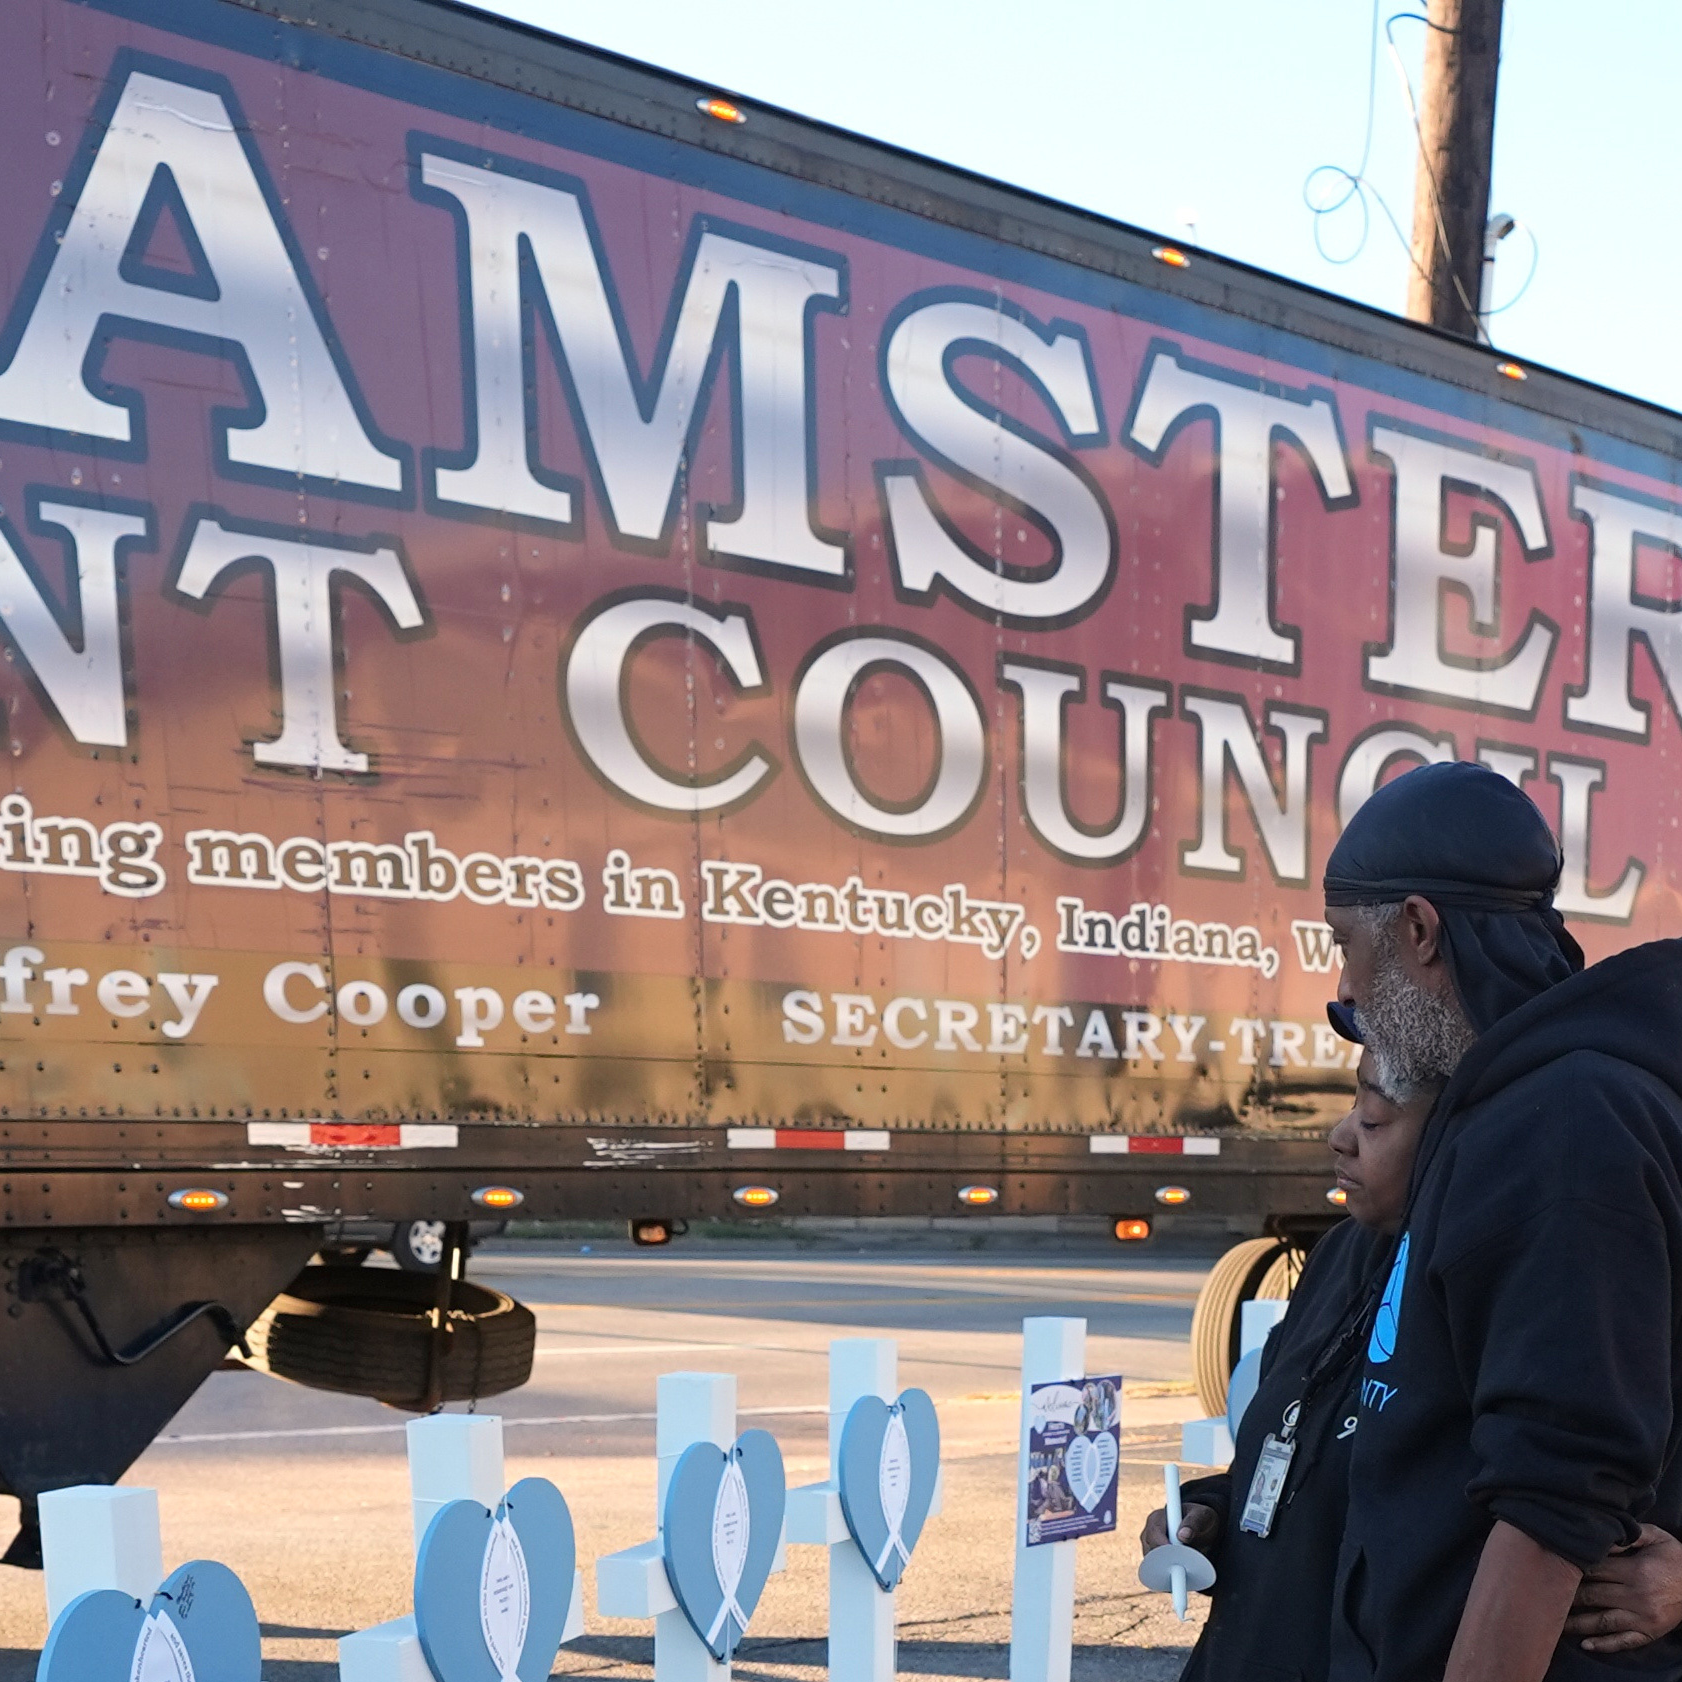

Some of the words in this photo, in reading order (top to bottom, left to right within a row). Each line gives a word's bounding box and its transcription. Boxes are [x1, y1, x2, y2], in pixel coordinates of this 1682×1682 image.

[564, 599, 1642, 918] COUNL
[186, 829, 584, 911] members
[604, 849, 685, 918] in
[700, 860, 1041, 959] Kentucky,
[1056, 896, 1280, 978] Indiana,
[263, 961, 599, 1047] Cooper
